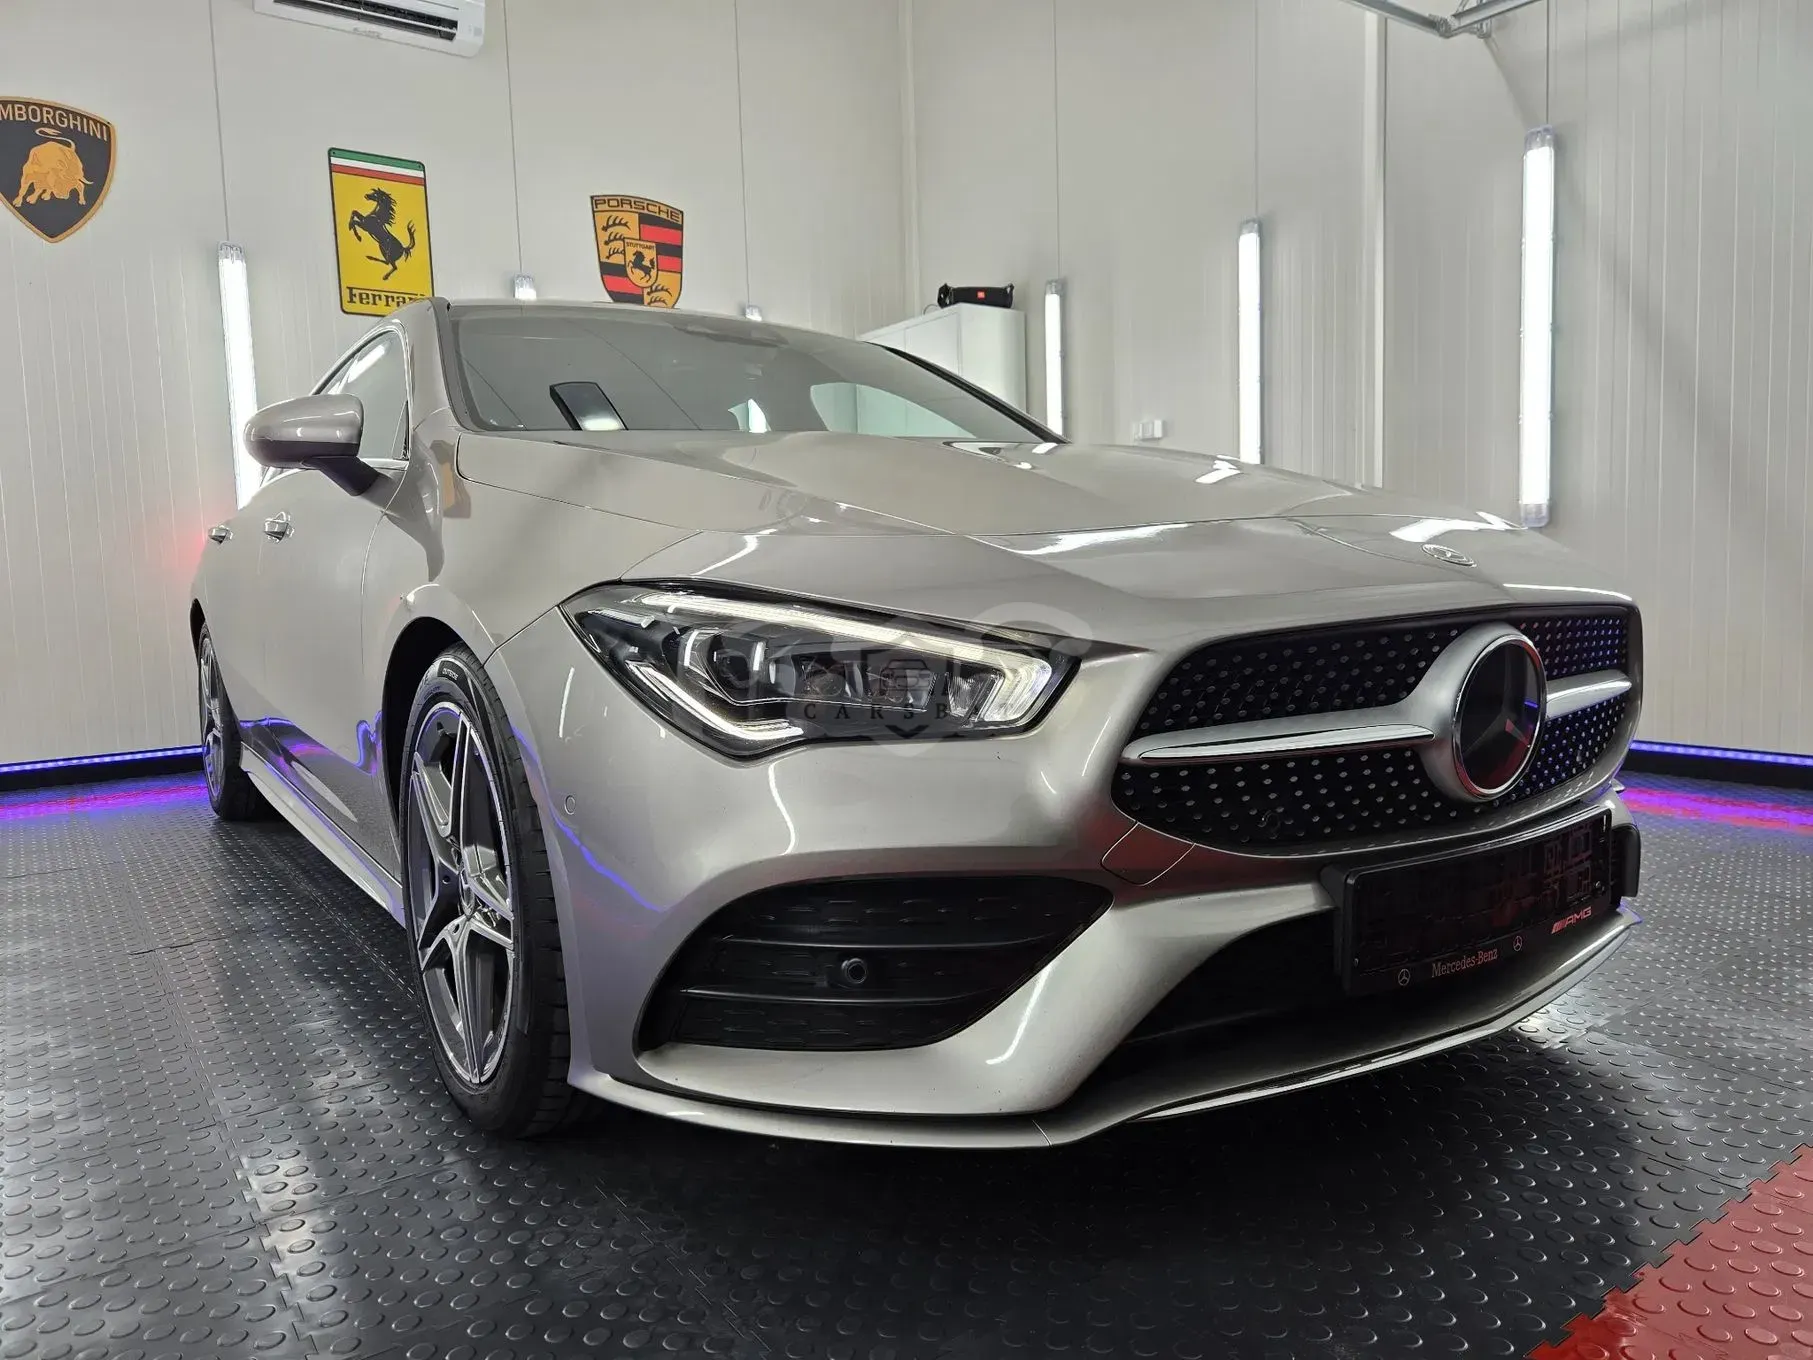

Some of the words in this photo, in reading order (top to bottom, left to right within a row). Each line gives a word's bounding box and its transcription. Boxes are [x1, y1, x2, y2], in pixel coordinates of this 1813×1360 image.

[0, 104, 108, 141] MBORGHINI
[595, 198, 680, 222] PORSCHE
[1563, 906, 1592, 927] AMG
[1431, 948, 1498, 978] Mercedes-Benz
